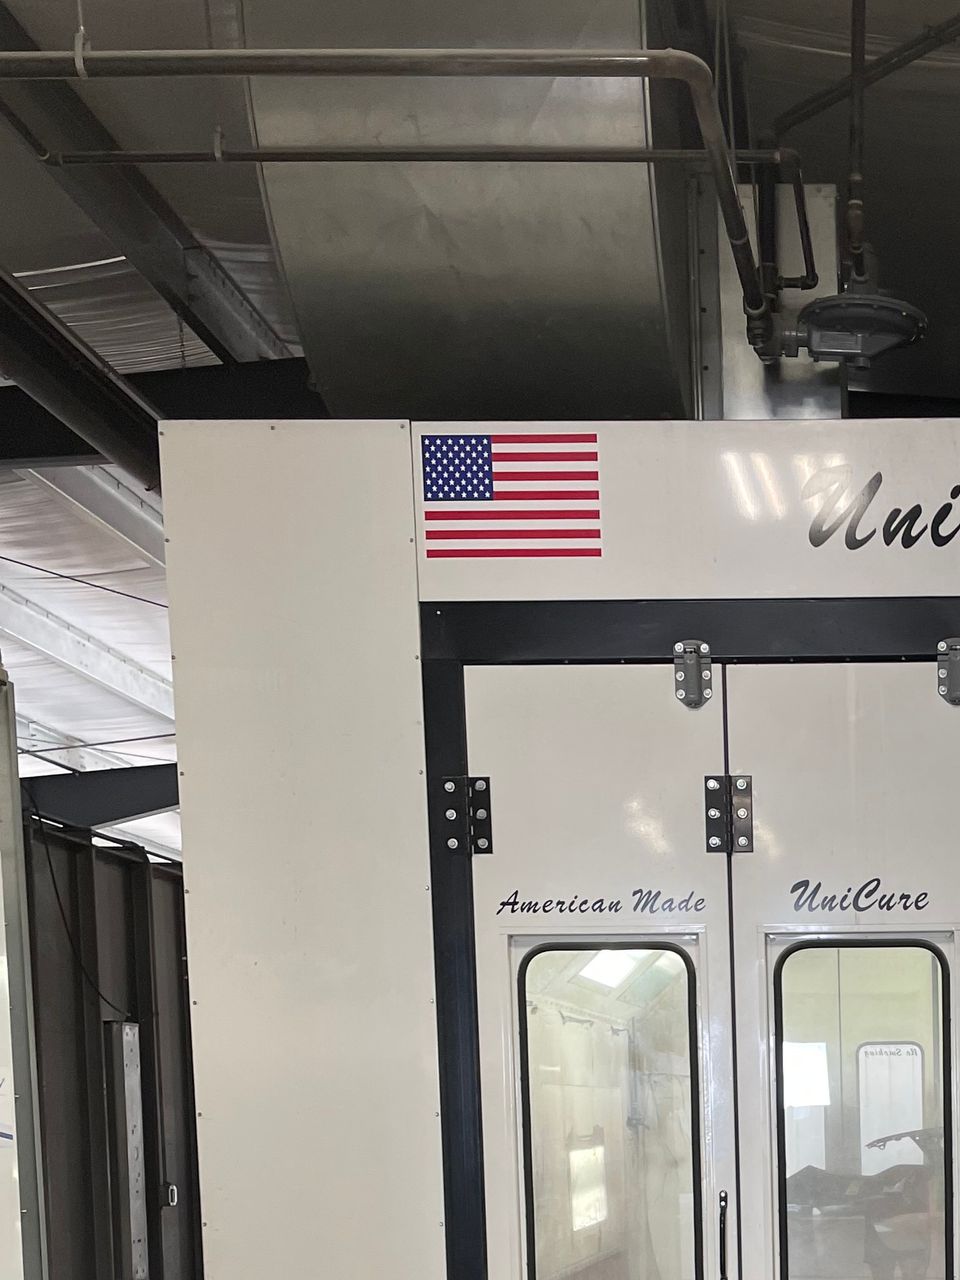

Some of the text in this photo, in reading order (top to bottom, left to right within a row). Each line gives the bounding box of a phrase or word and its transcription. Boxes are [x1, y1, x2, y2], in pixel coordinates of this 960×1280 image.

[497, 889, 706, 915] American Made
[790, 878, 930, 912] UniCure
